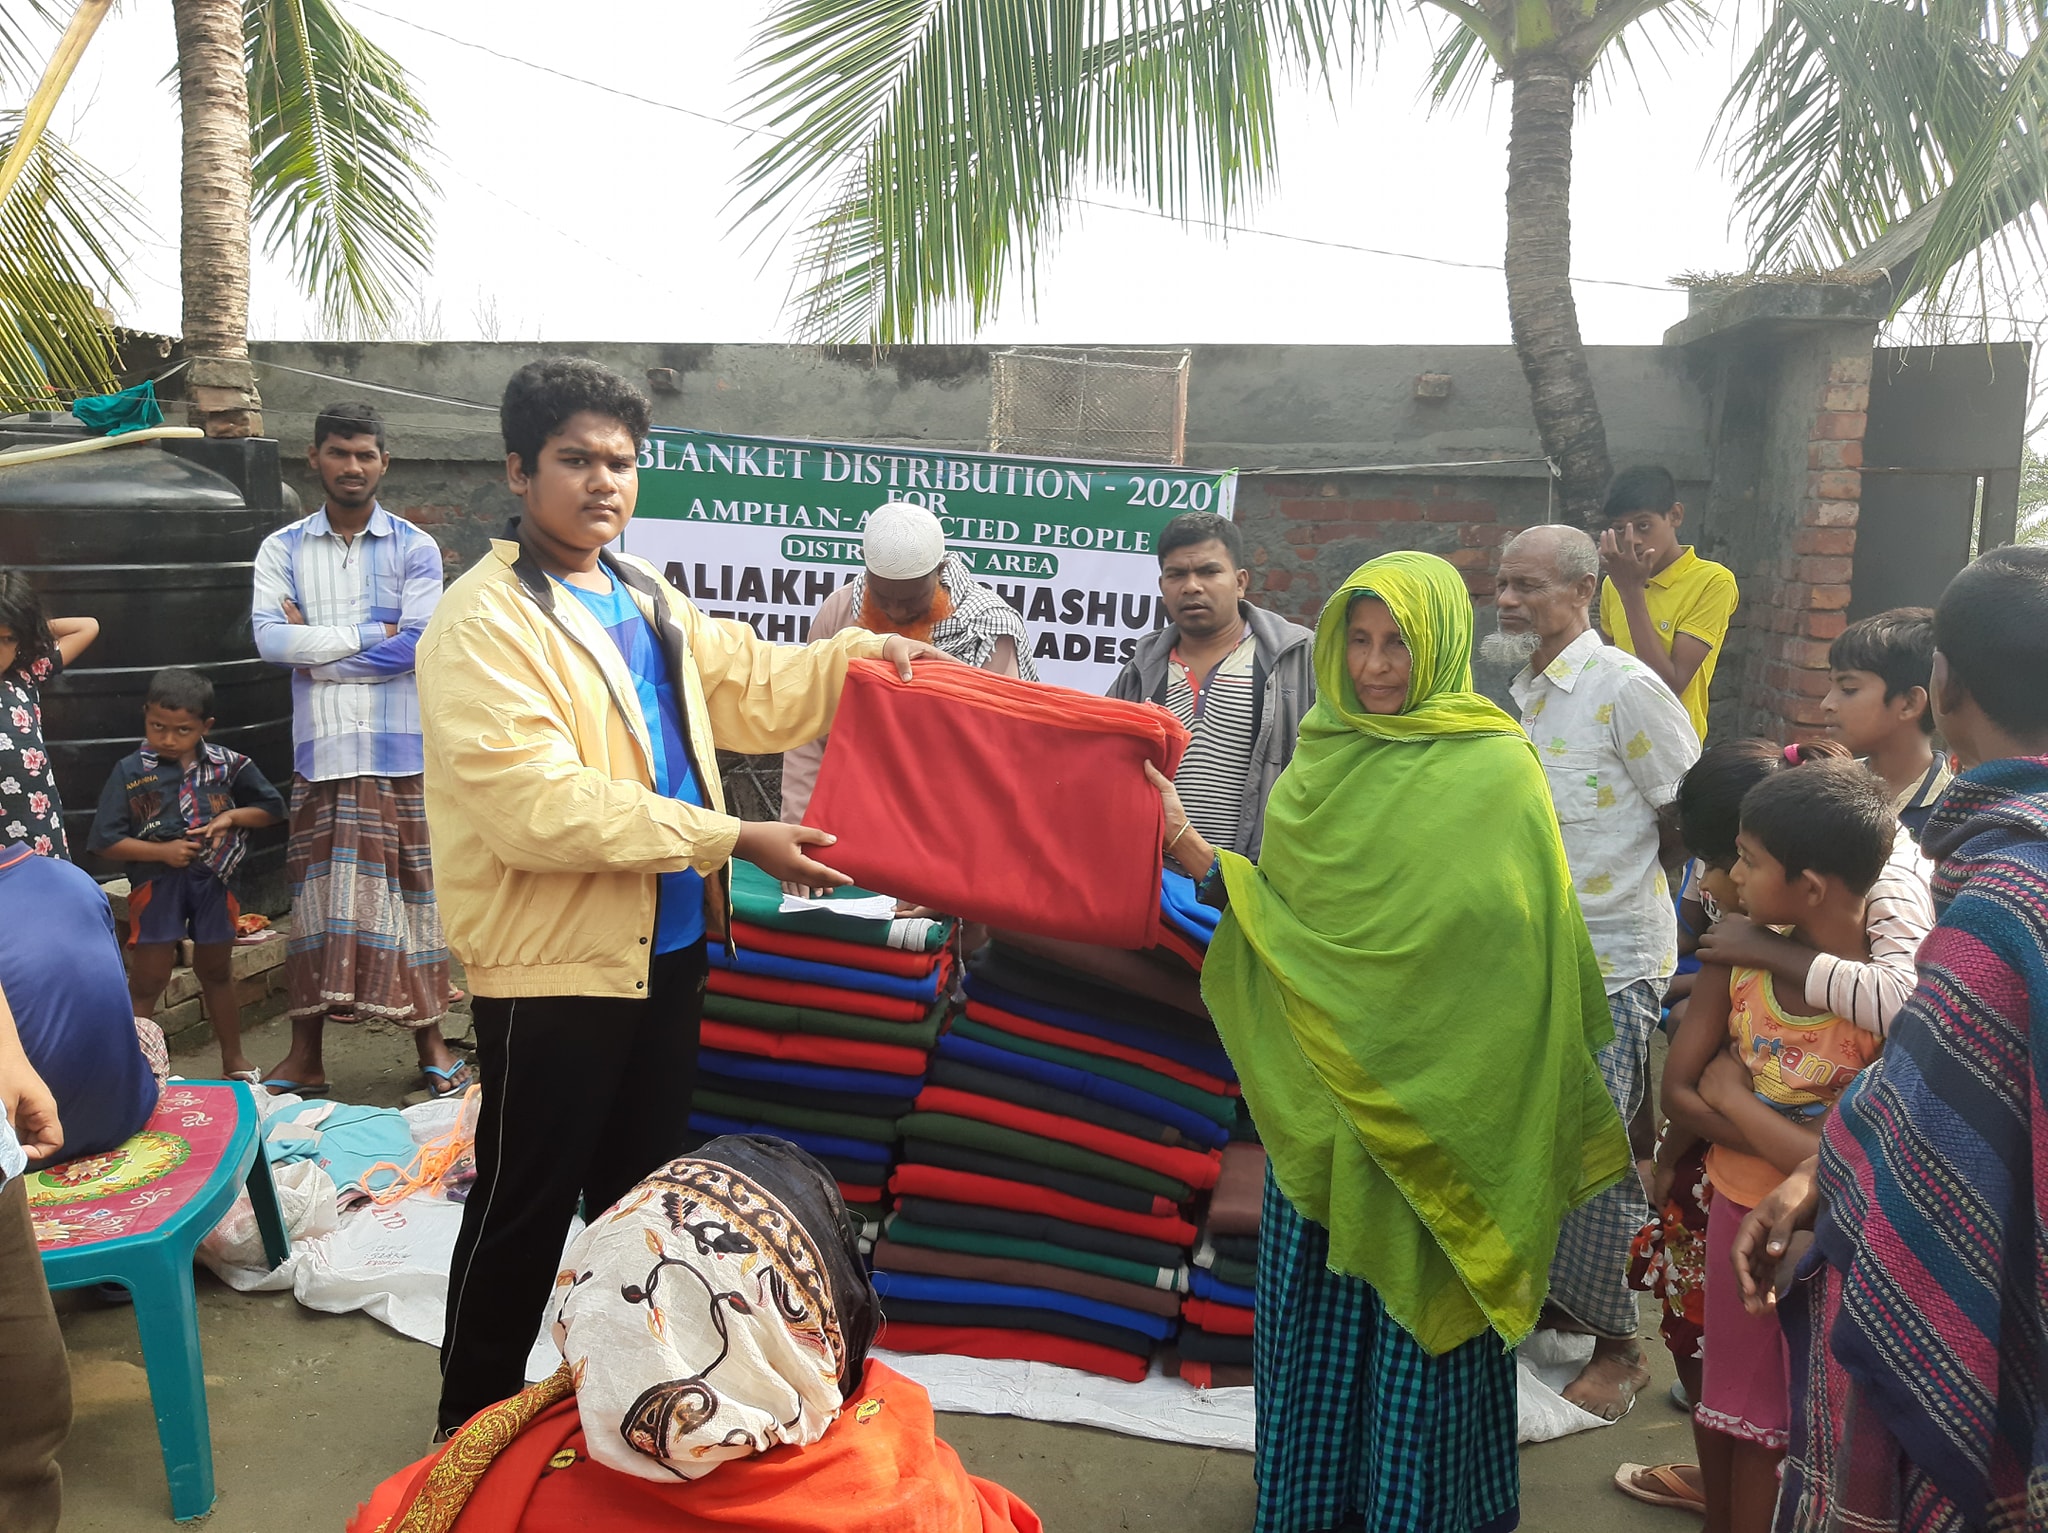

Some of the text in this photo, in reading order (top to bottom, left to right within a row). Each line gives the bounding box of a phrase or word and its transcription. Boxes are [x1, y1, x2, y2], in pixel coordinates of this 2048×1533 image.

[636, 438, 1213, 512] BLANKET DISTRIBUTION - 2020
[686, 497, 1151, 552] AMPHAN-ACTED PEOPLE
[886, 488, 950, 514] FOR
[663, 560, 858, 608] ALIAKH
[985, 553, 1056, 575] AREA
